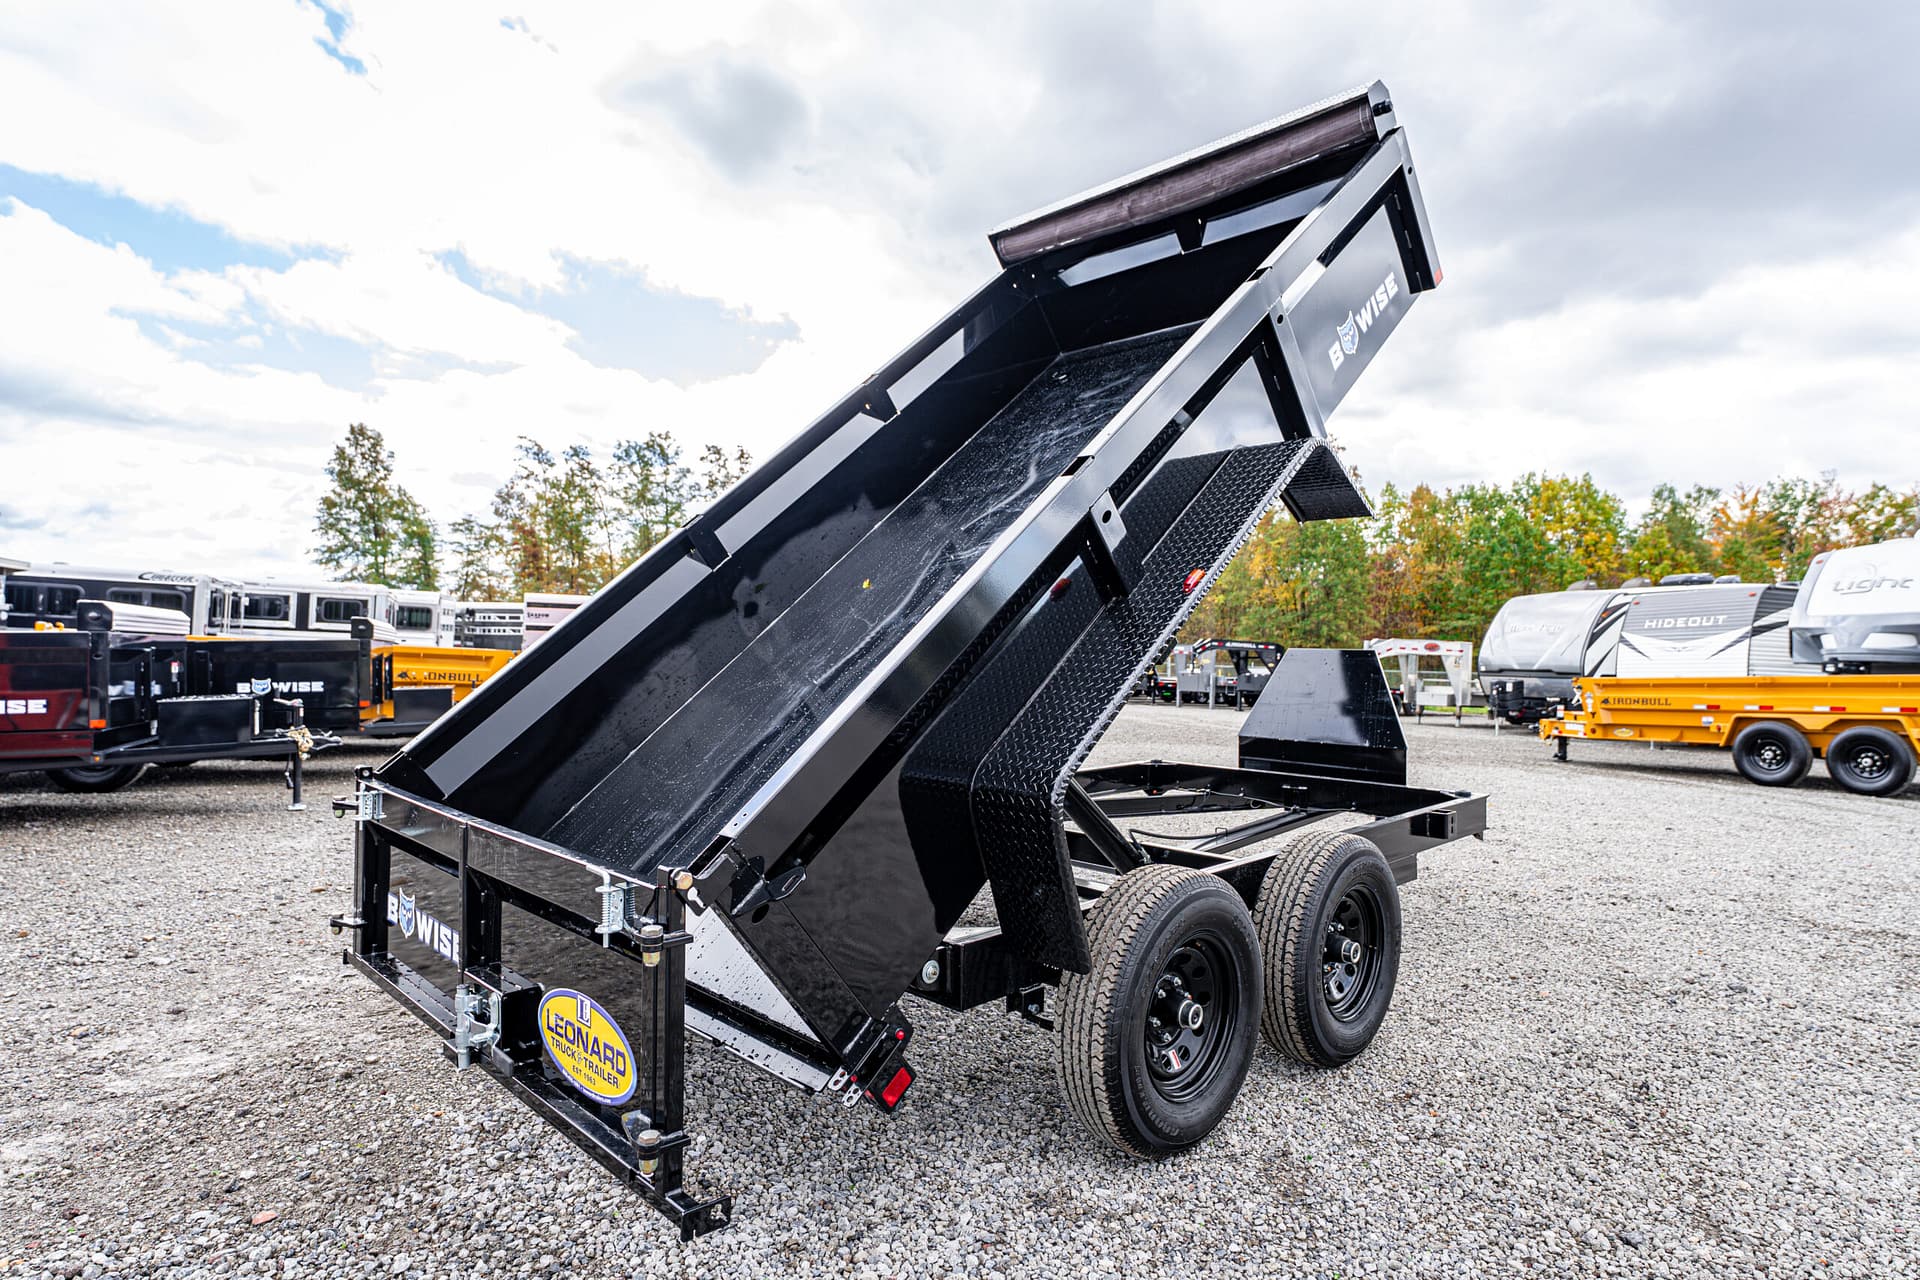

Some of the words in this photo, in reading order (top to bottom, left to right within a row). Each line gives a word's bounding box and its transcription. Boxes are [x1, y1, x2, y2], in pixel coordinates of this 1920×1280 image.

[1644, 615, 1728, 629] HIDEOUT
[413, 671, 480, 682] ONBULL
[546, 1007, 626, 1077] LEONARD
[551, 1035, 576, 1061] TRUCK
[583, 1056, 619, 1088] TRAILER
